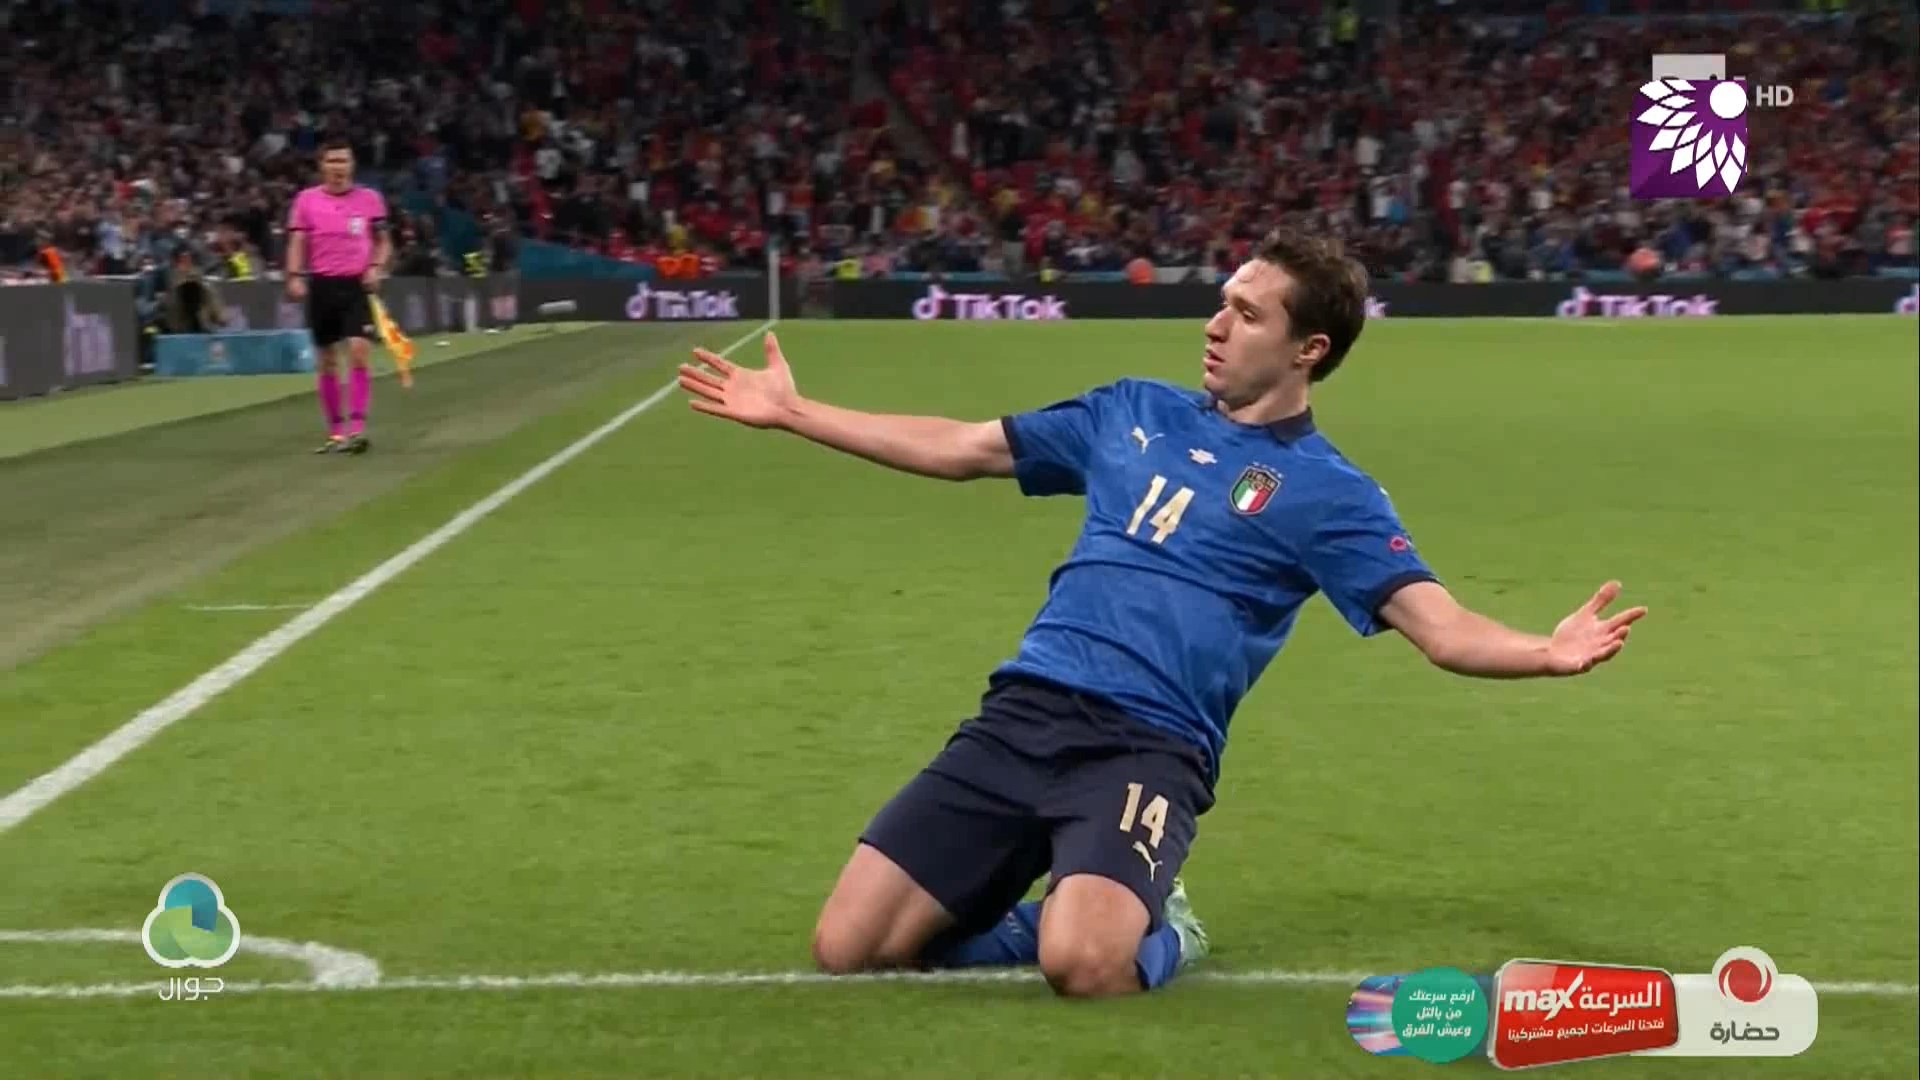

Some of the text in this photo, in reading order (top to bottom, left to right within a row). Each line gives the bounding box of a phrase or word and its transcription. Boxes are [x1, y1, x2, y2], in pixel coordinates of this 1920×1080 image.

[655, 290, 739, 318] TikTok
[952, 294, 1066, 320] TikTok
[1596, 294, 1720, 316] TikTok
[1126, 474, 1195, 544] 14
[1119, 782, 1169, 850] 14
